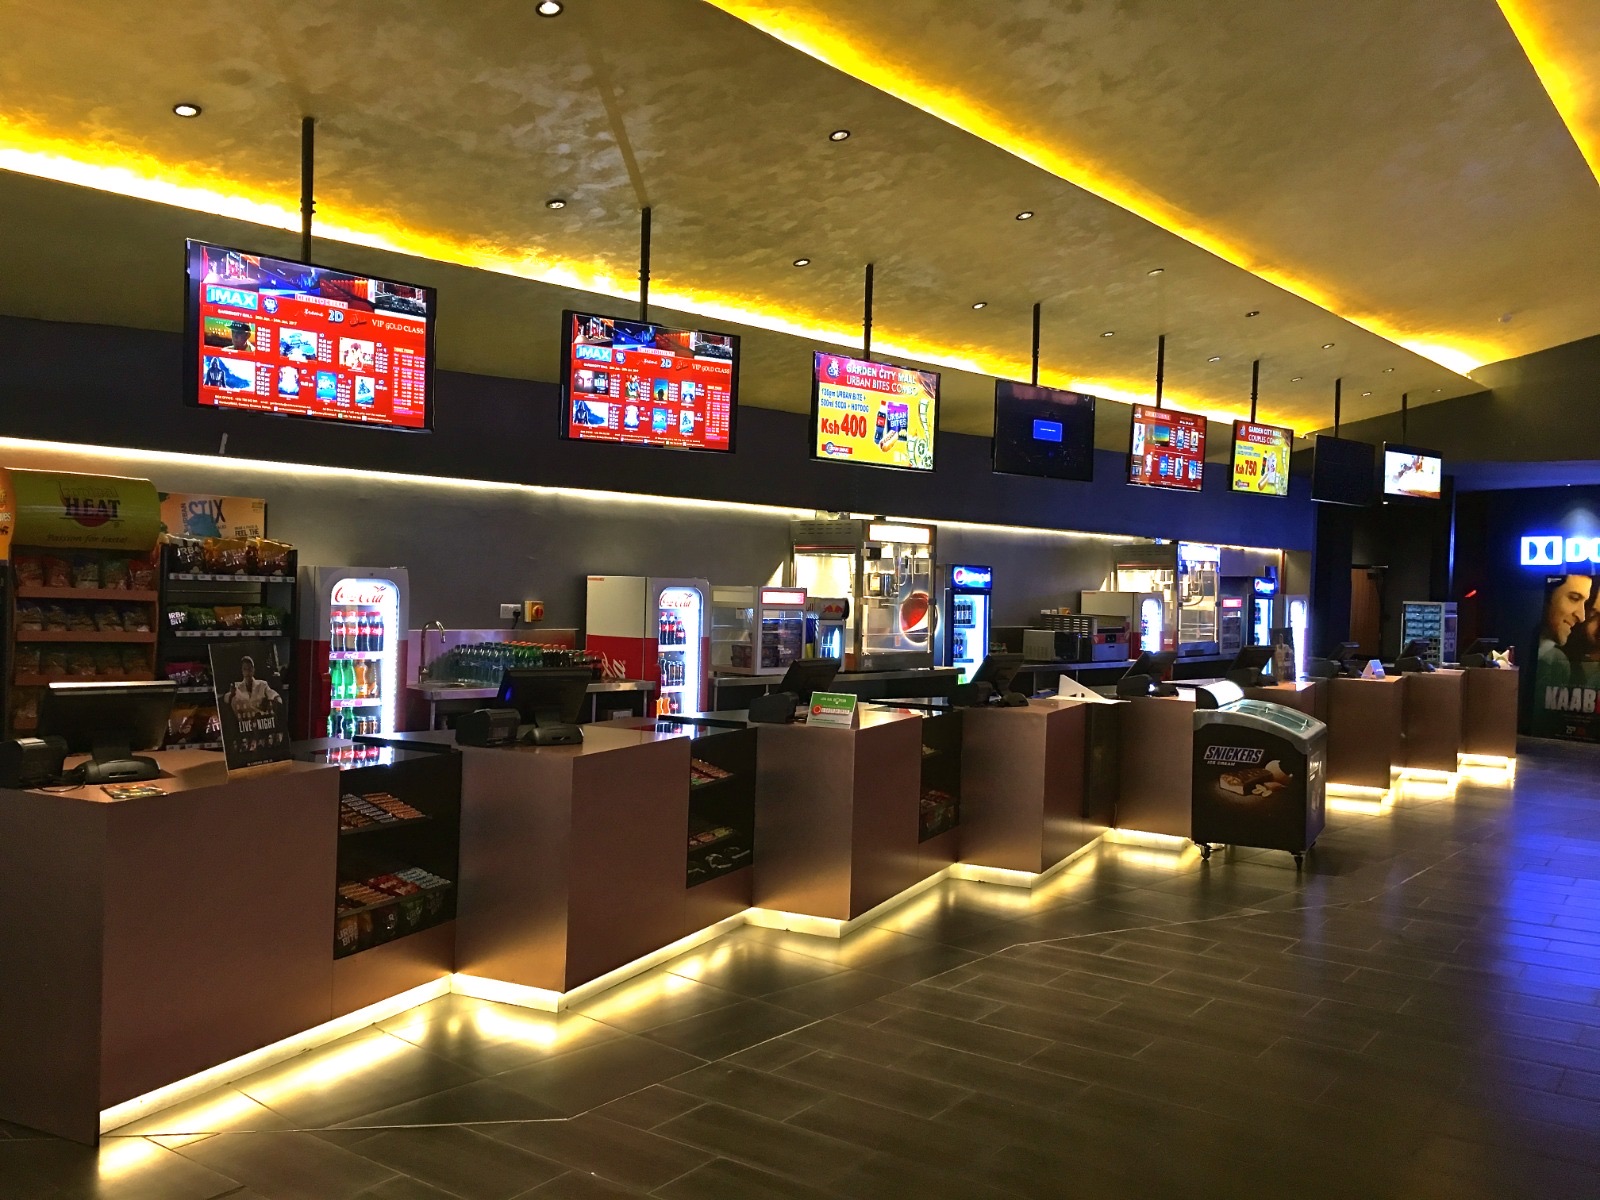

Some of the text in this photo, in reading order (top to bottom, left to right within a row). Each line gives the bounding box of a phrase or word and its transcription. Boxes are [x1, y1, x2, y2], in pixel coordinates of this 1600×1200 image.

[208, 288, 255, 308] IMAX
[328, 309, 344, 322] 2D
[372, 319, 384, 328] VIP
[403, 325, 424, 335] CLASS
[579, 346, 610, 360] IMAX
[660, 357, 672, 369] 2D
[692, 363, 702, 371] VIP
[714, 367, 731, 375] CLASS
[846, 363, 917, 384] GARDEN CITY MALL
[847, 375, 871, 389] URBAN
[873, 379, 890, 391] BITES
[837, 390, 852, 400] URBAN
[852, 392, 863, 402] BITE
[851, 403, 869, 413] HOTDOG
[887, 411, 907, 421] URBAN
[890, 418, 907, 428] BITES
[821, 413, 867, 438] Ksh 400
[1248, 425, 1264, 435] GARDEN
[1236, 460, 1257, 477] Ksh 750
[65, 497, 121, 518] HEAT
[84, 534, 99, 544] for
[238, 720, 252, 733] LIVE
[257, 717, 275, 730] NIGHT
[1205, 747, 1263, 763] SNICKERS
